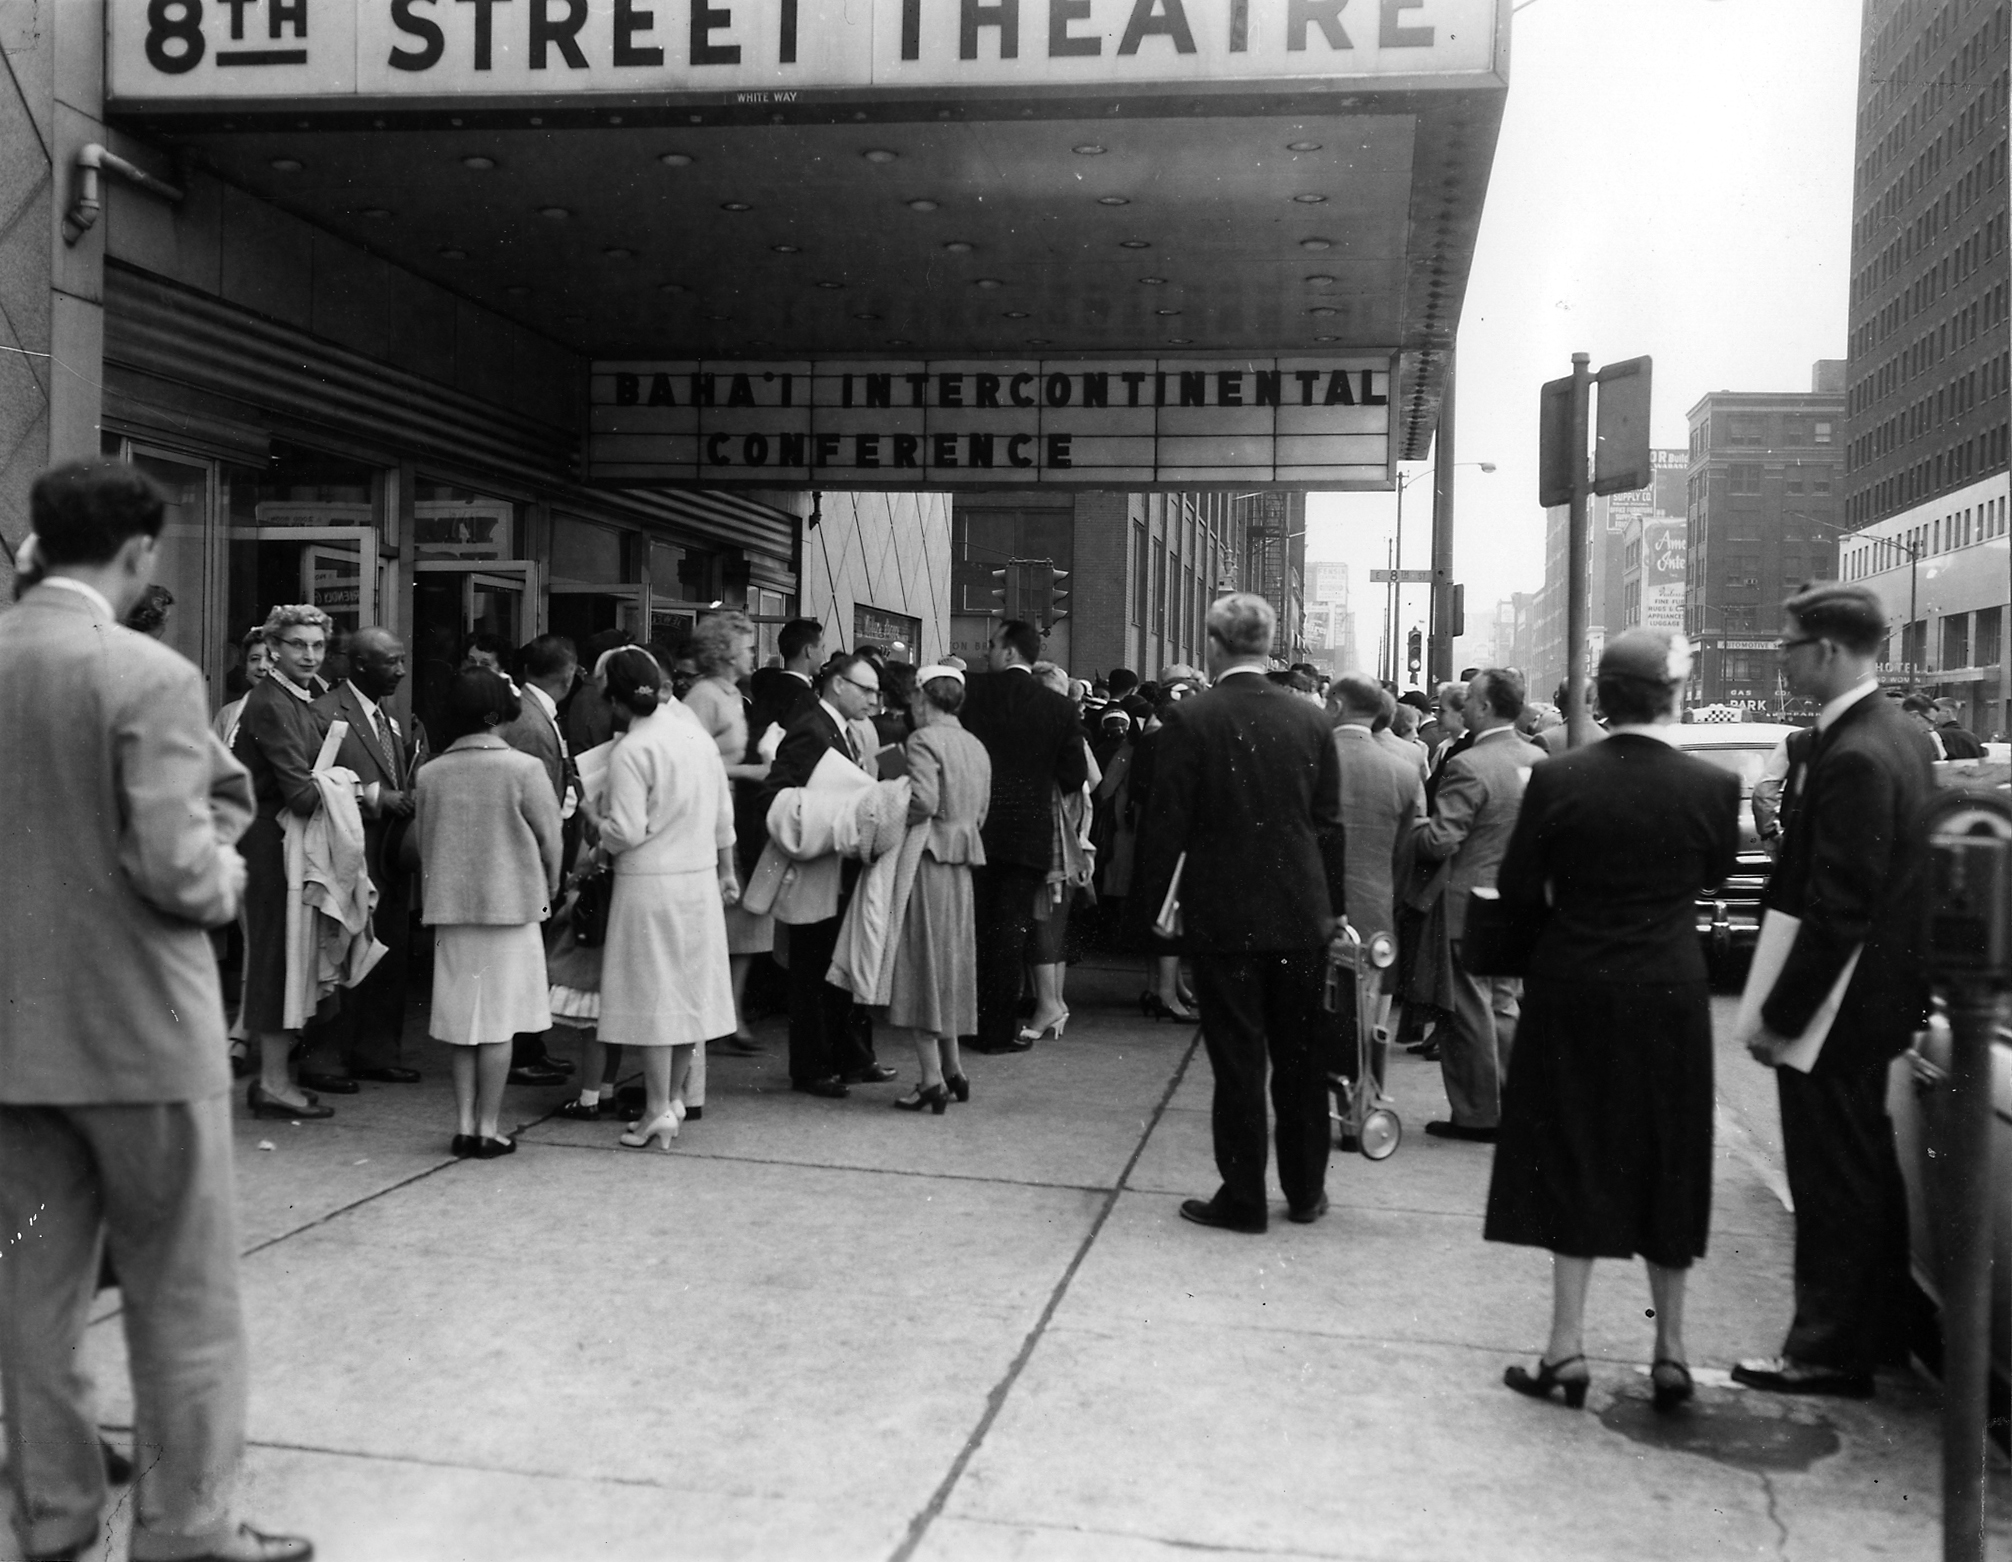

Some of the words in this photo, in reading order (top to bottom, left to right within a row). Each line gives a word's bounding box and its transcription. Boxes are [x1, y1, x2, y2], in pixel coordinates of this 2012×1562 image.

[144, 0, 307, 74] 8TH
[387, 0, 797, 72] STREET
[900, 0, 1436, 61] THEATRE
[737, 92, 769, 103] WHITE
[773, 91, 797, 102] WAY
[842, 369, 1387, 409] INTERCONTINENTAL
[706, 431, 1072, 470] CONFERENCE
[1613, 491, 1641, 502] SUPPLY
[1375, 571, 1381, 580] E
[1417, 572, 1427, 581] ST
[1875, 662, 1921, 674] HOTEL
[1730, 700, 1767, 711] PARK
